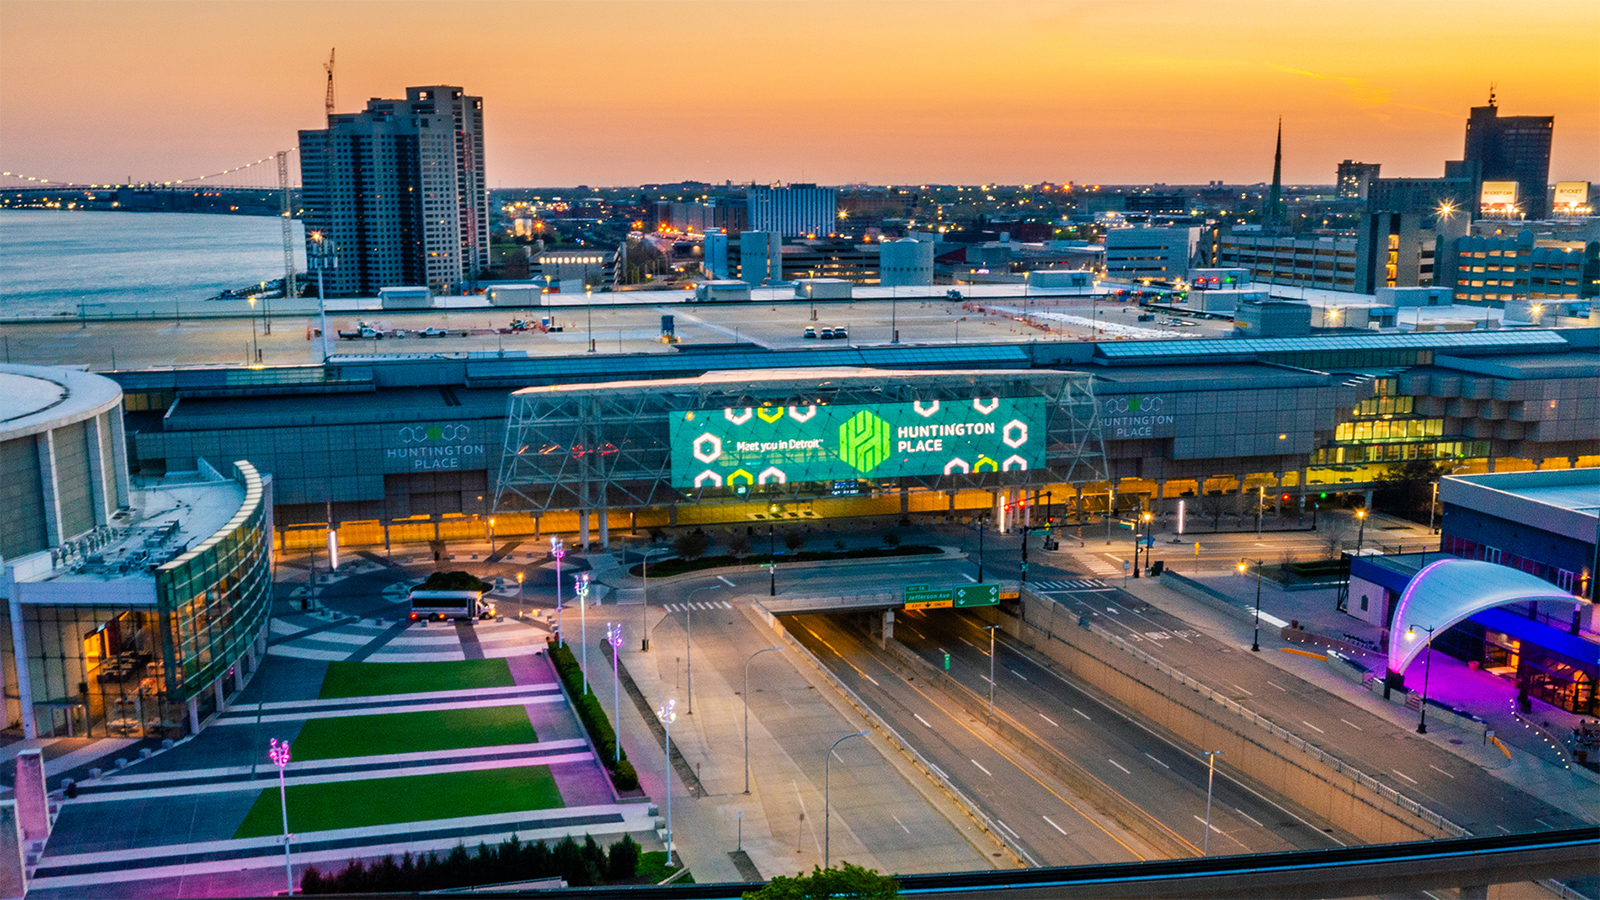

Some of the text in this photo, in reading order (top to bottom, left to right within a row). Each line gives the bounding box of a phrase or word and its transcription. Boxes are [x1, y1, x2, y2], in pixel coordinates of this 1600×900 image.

[898, 422, 995, 438] HUNTINGTON
[1116, 426, 1152, 437] PLACE
[387, 444, 484, 458] HUNTINGTON
[736, 441, 760, 451] Meet
[760, 442, 778, 453] you
[778, 439, 788, 450] in
[898, 439, 943, 452] PLACE
[414, 457, 459, 469] PLACE
